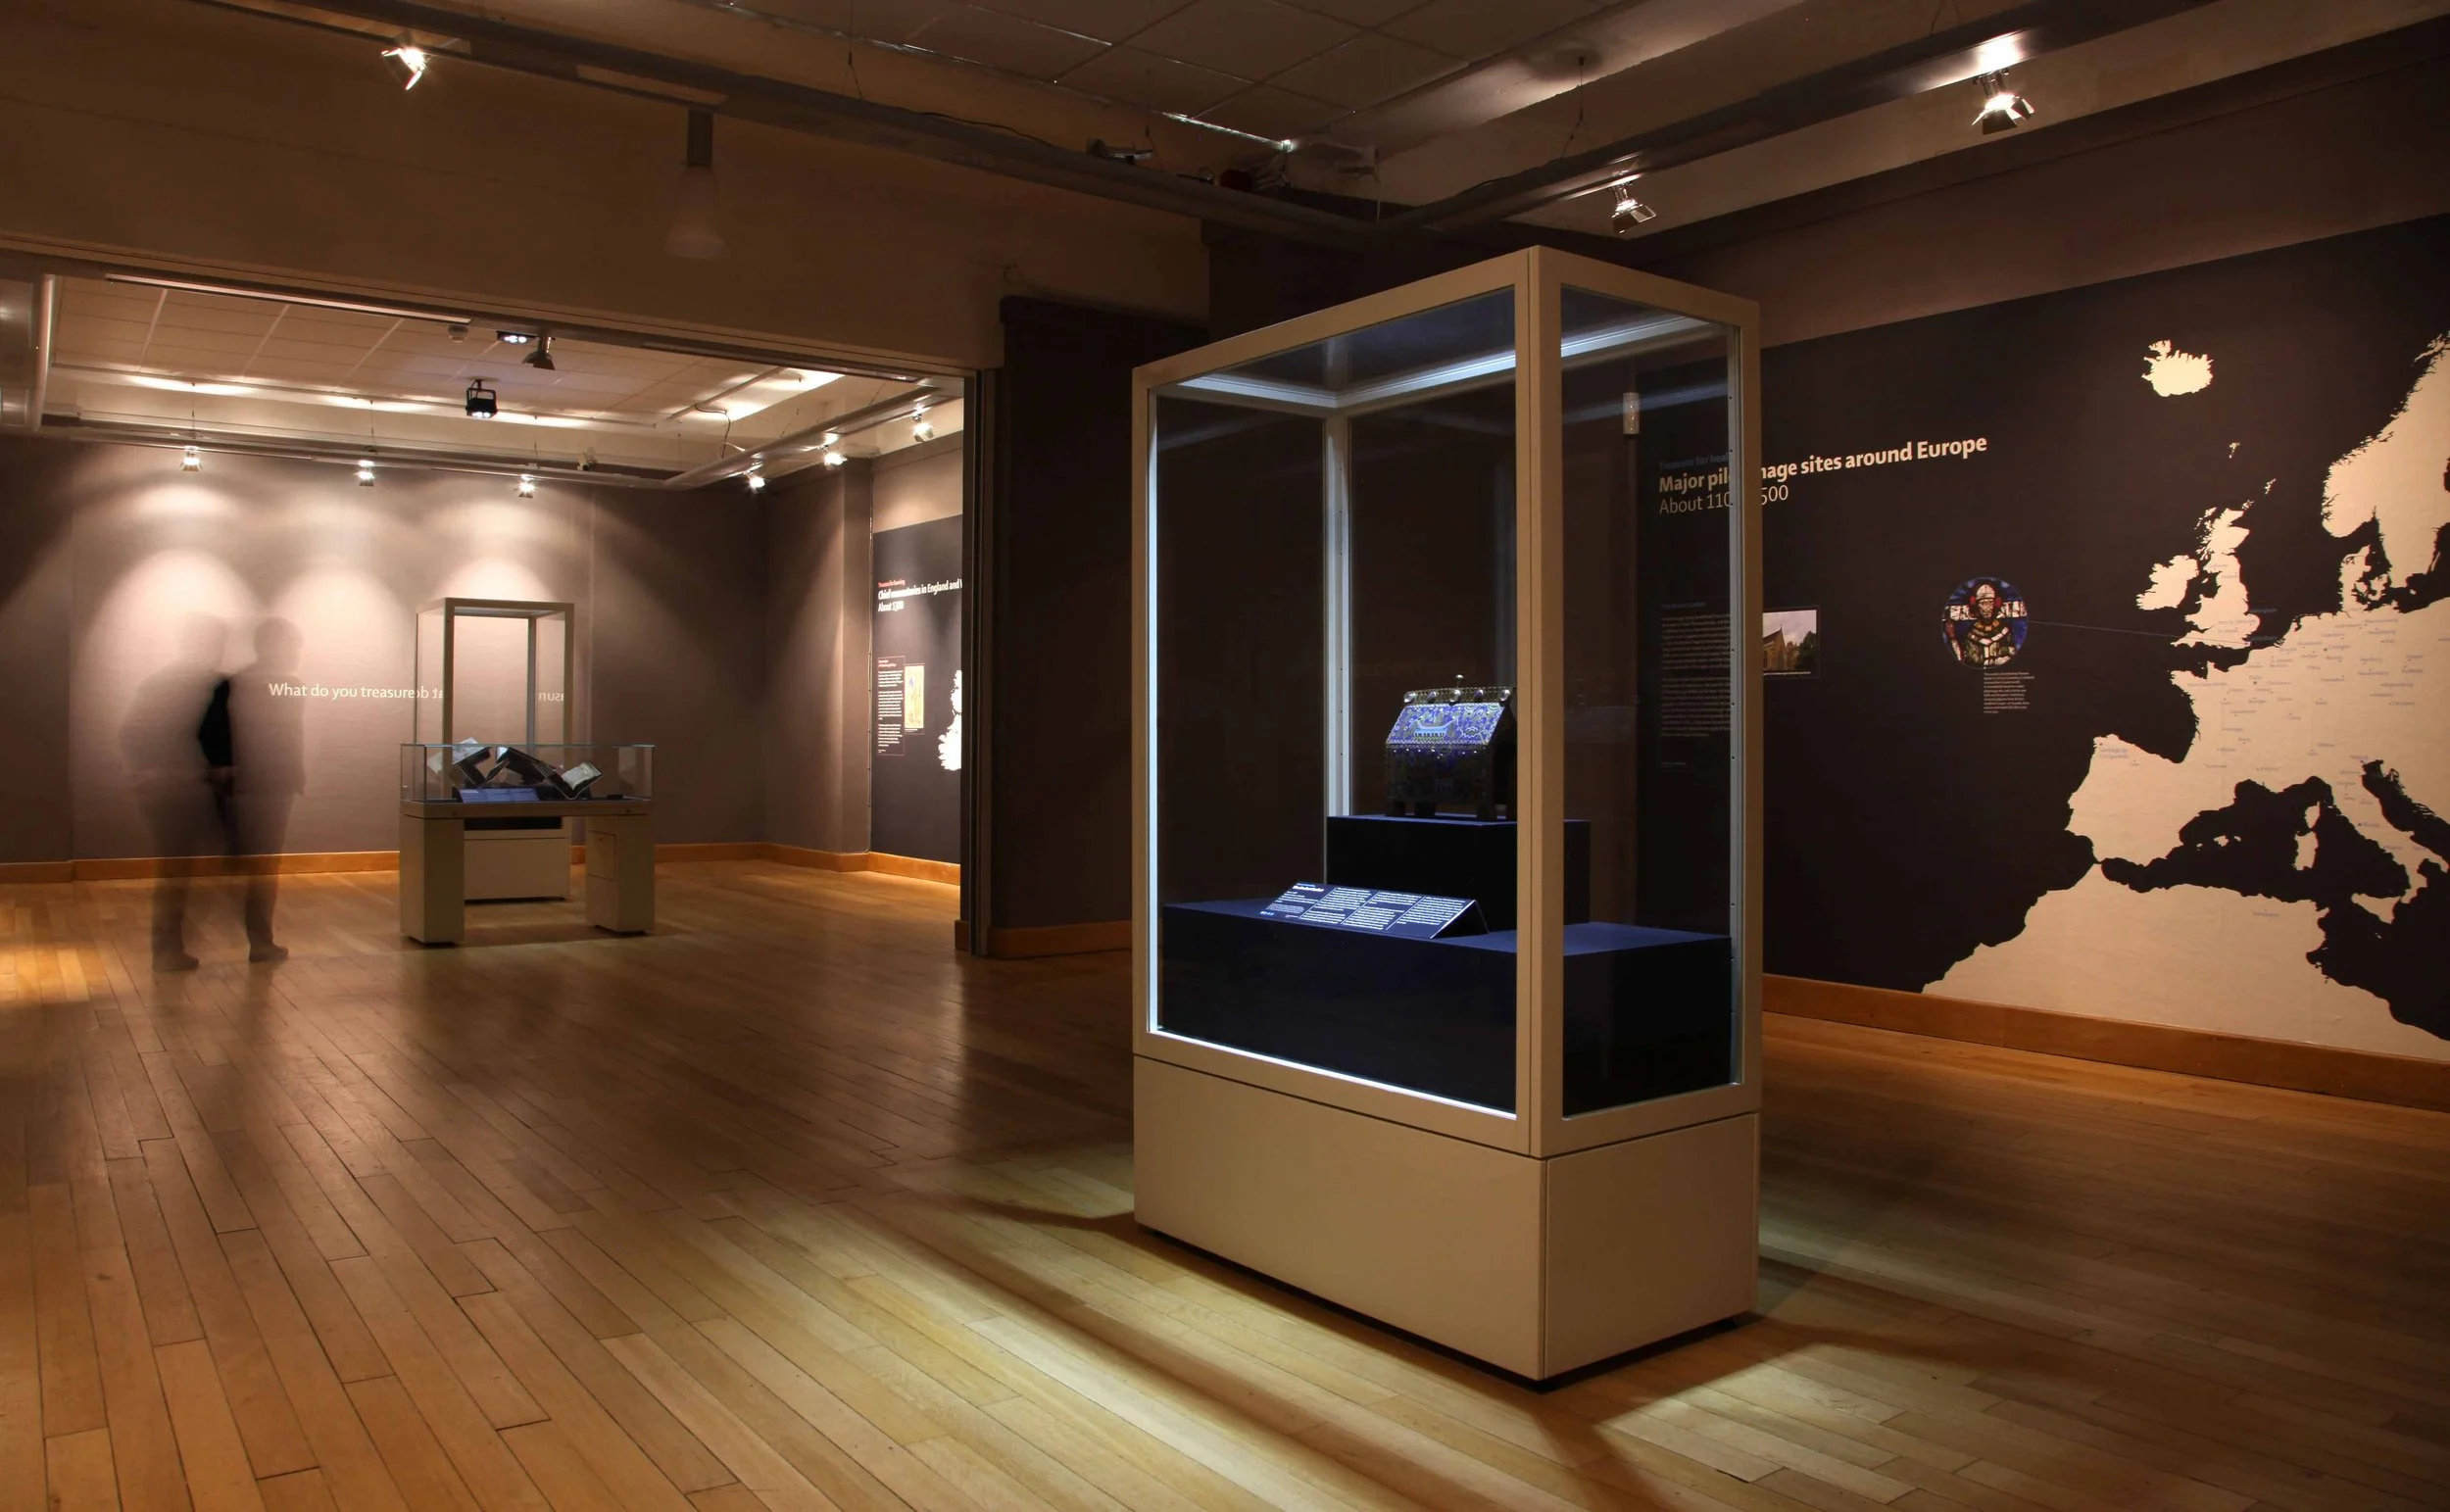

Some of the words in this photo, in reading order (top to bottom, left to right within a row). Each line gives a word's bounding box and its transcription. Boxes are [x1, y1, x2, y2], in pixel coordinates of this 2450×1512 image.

[1658, 472, 1705, 495] Major
[1800, 455, 1842, 474] sites
[1845, 441, 1912, 468] around
[1917, 437, 1987, 460] Europe
[1658, 496, 1703, 514] About
[928, 580, 949, 596] England
[950, 578, 959, 589] and
[269, 682, 309, 697] What
[311, 683, 329, 698] do
[332, 686, 358, 701] you
[361, 686, 416, 699] treasure
